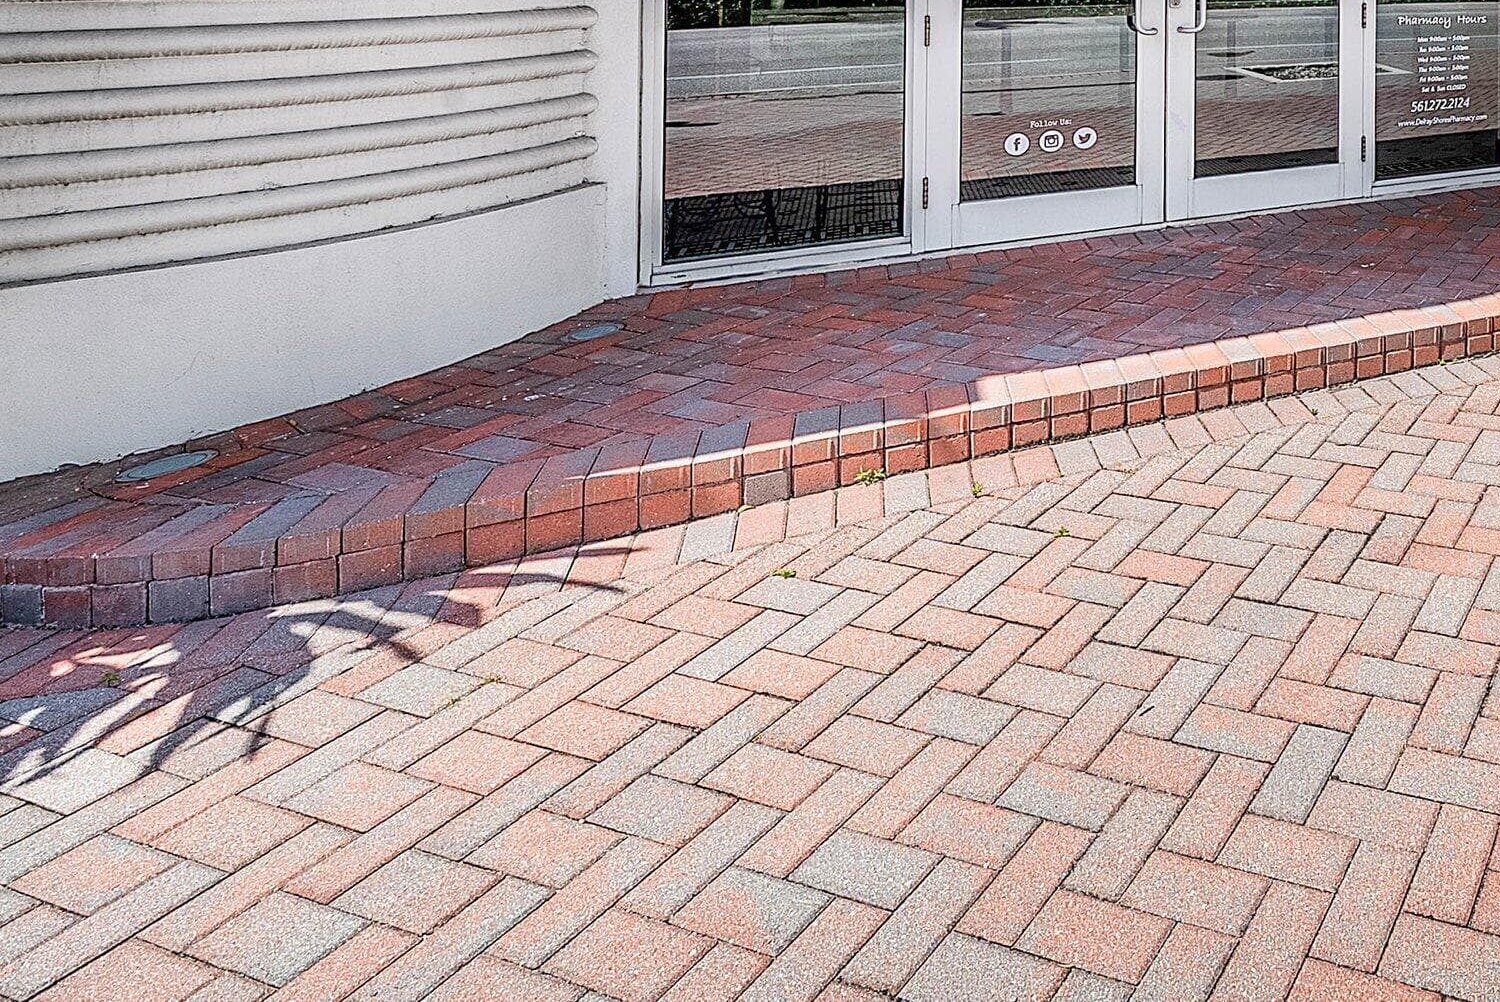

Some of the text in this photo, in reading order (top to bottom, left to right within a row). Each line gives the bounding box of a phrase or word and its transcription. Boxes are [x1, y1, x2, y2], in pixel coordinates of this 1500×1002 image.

[1398, 15, 1487, 29] Pharmacy Hours
[1030, 119, 1058, 129] Follow
